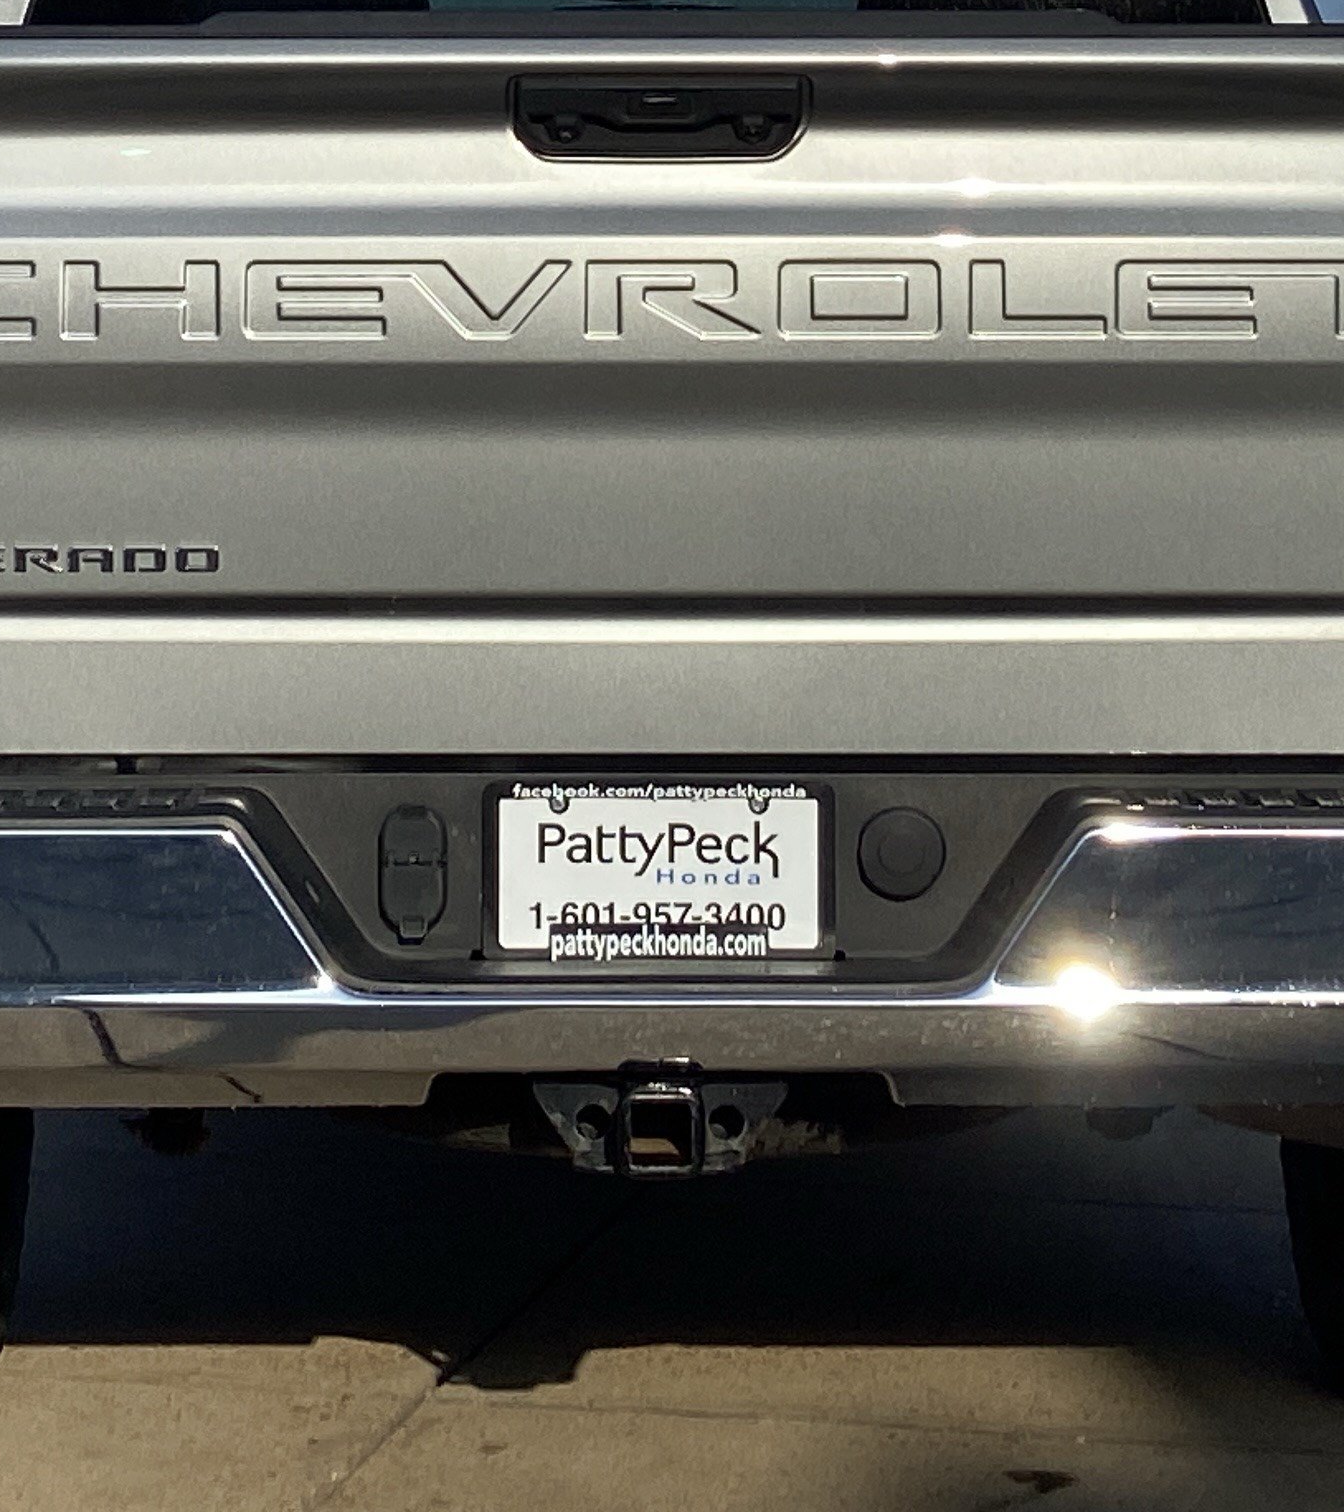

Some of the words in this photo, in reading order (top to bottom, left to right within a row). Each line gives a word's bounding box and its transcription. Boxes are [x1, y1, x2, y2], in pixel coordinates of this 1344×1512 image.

[512, 782, 807, 802] facebook.com/pattypeckhonda
[537, 820, 780, 879] PattyPeck
[656, 868, 761, 886] Honda
[528, 901, 786, 931] 1-601-957-3400
[550, 924, 768, 963] pattypeckhonda.com
